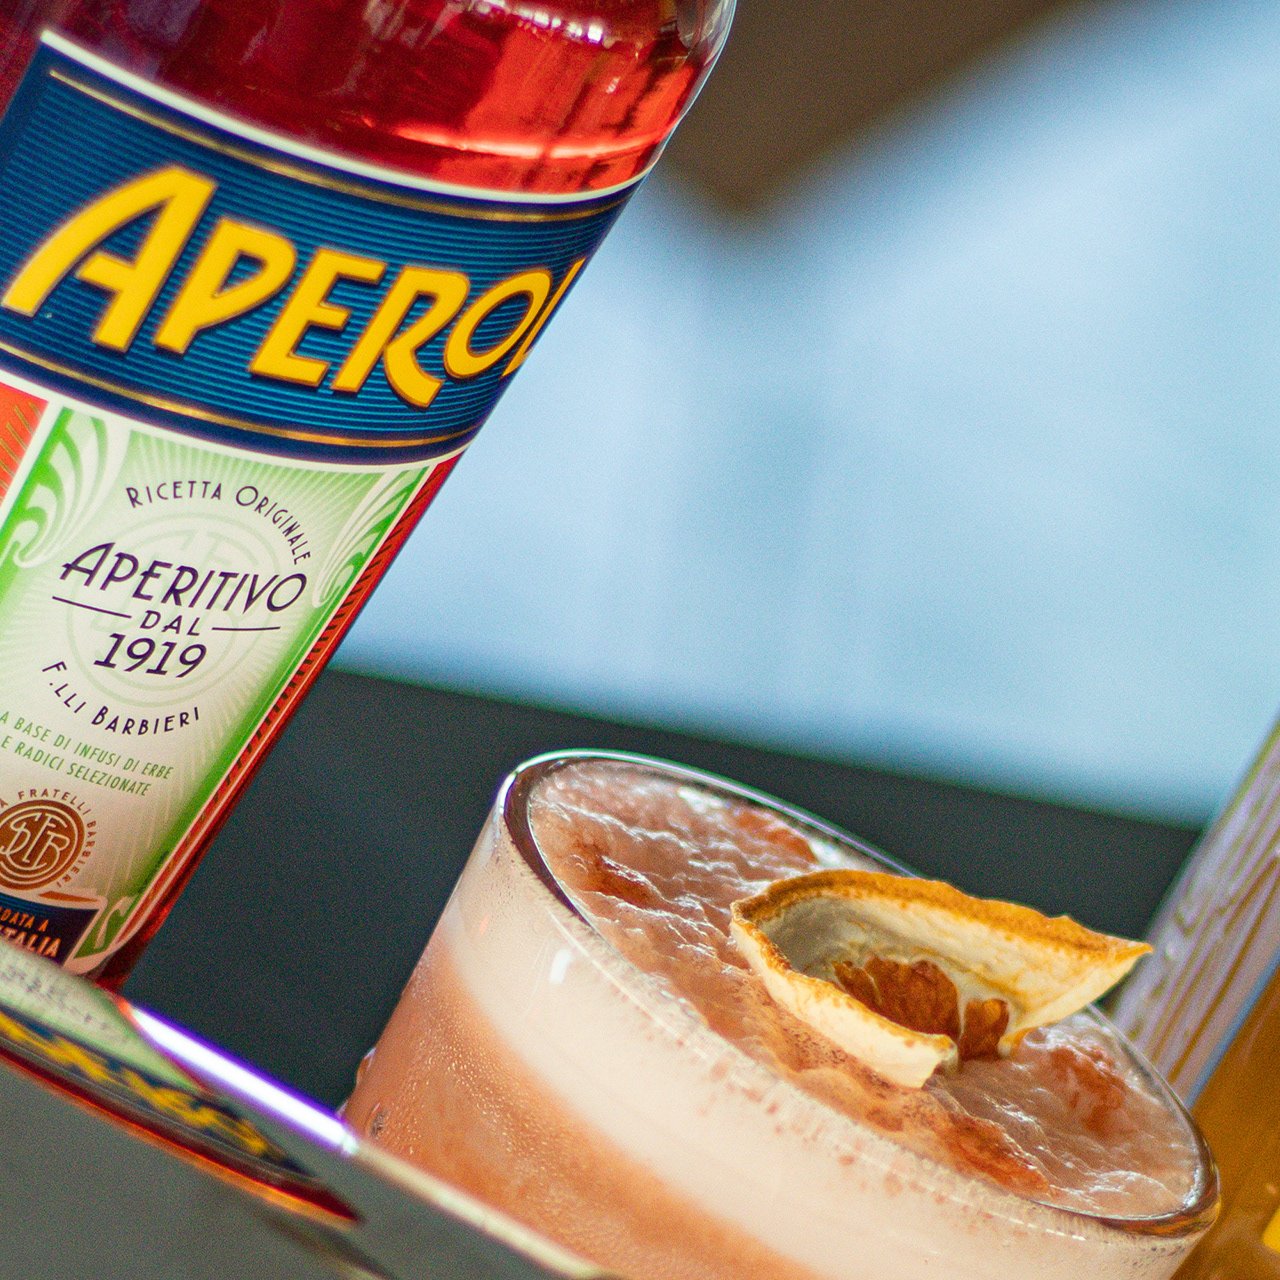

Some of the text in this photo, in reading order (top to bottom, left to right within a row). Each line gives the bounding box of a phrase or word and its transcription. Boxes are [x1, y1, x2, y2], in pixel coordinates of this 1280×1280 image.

[126, 480, 311, 565] RICETTA ORIGINALE
[59, 541, 308, 615] APERITIVO
[139, 610, 201, 636] DAL
[93, 632, 207, 678] 1919
[91, 705, 200, 736] BARBIERI
[1, 735, 152, 797] E RADICI SELEZIONATE
[13, 716, 52, 743] BASE
[53, 734, 71, 750] DI
[73, 742, 121, 767] INFUSI
[123, 757, 141, 772] DI
[141, 762, 174, 780] ERBE
[18, 788, 92, 816] FRATELLI
[38, 918, 49, 933] A
